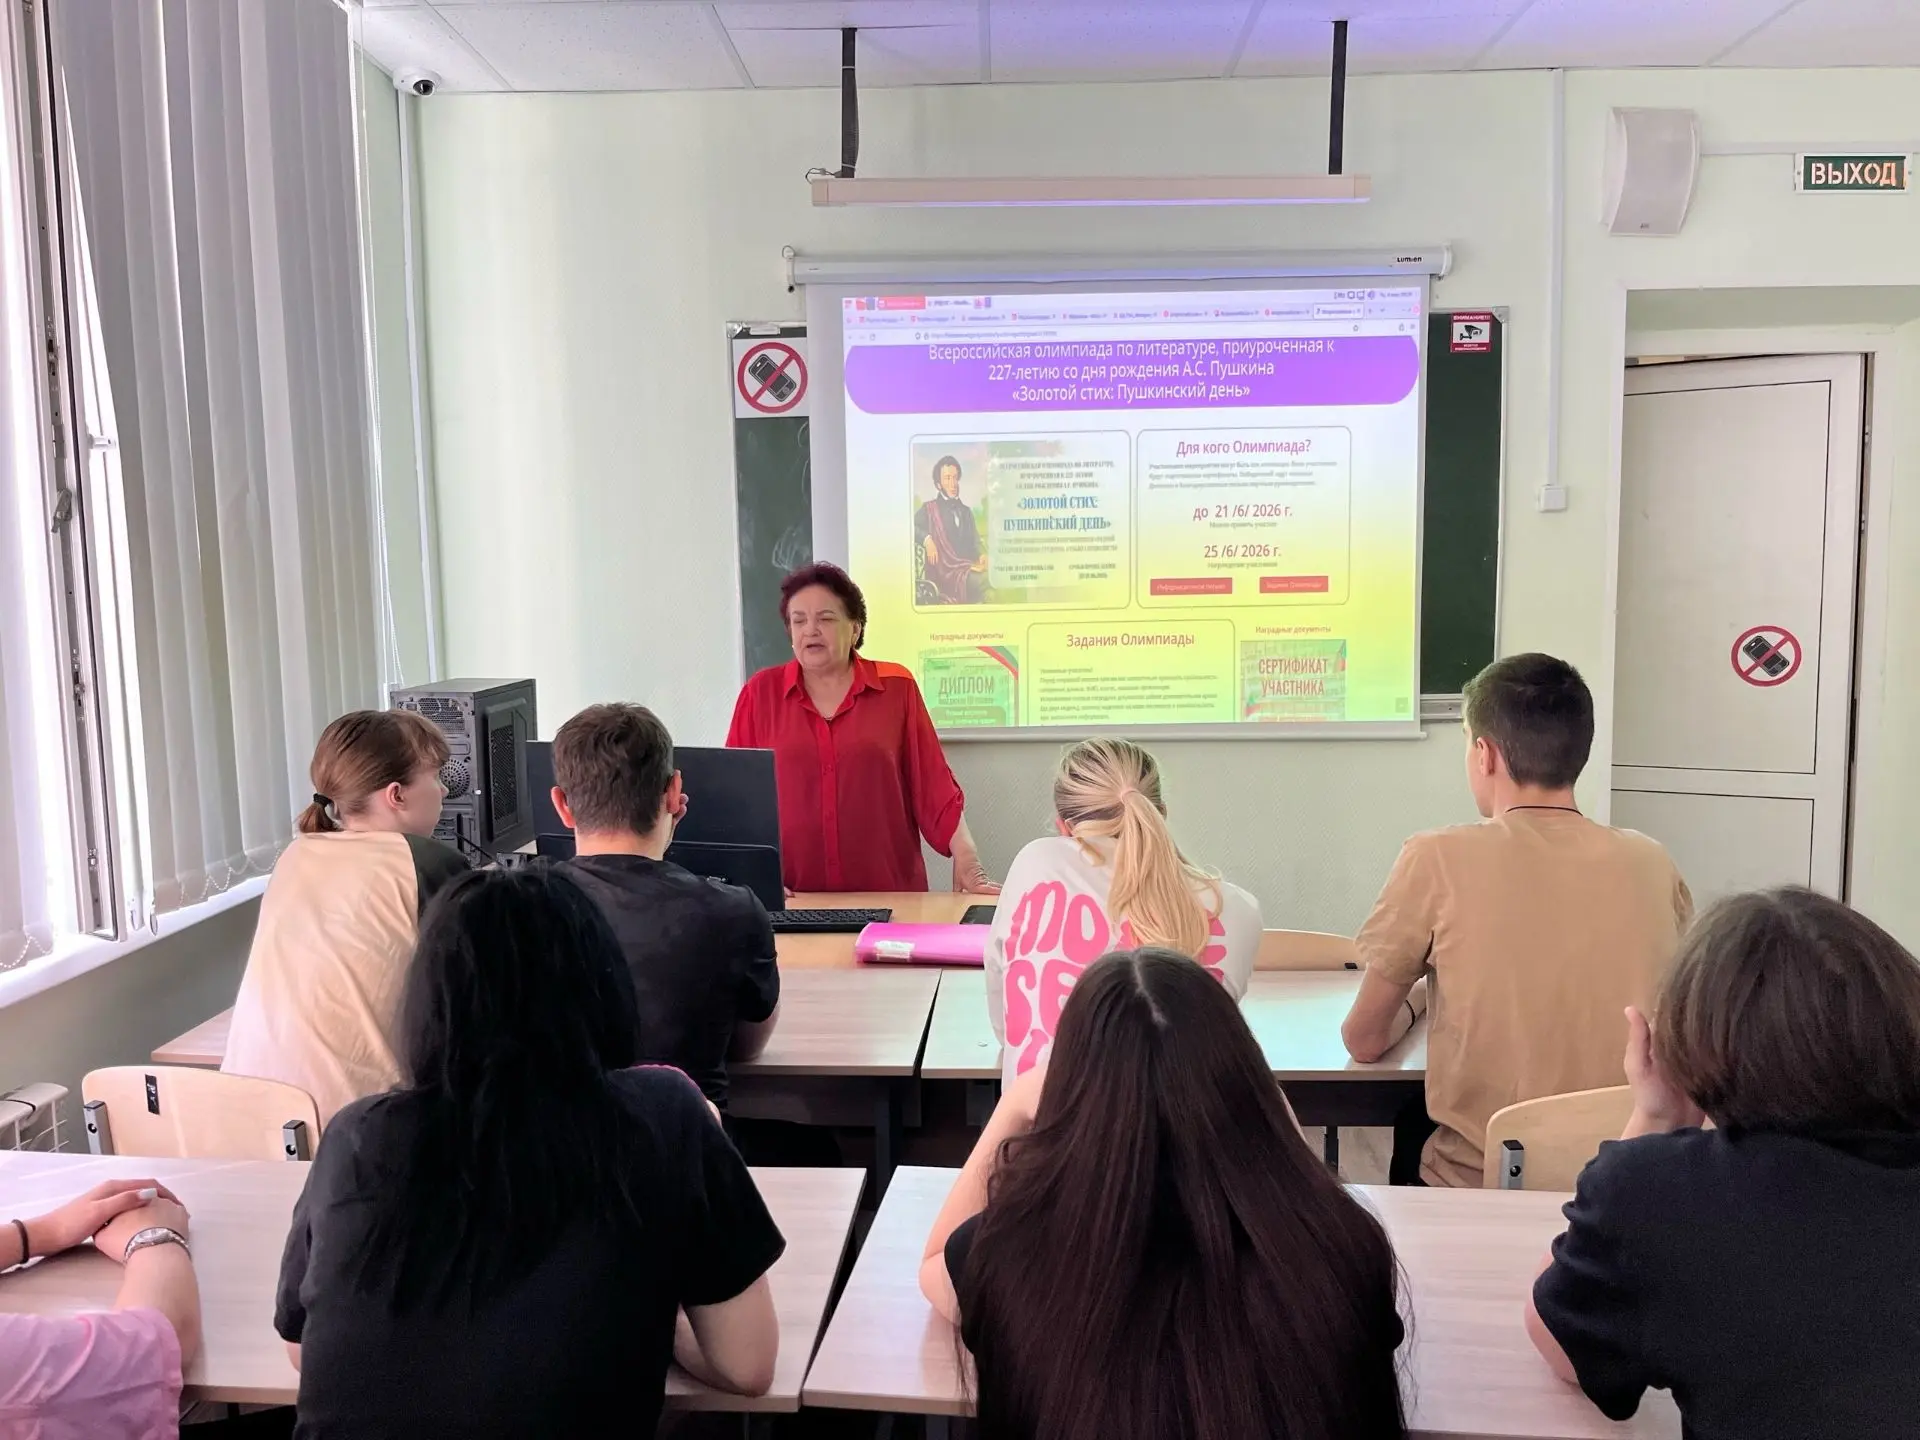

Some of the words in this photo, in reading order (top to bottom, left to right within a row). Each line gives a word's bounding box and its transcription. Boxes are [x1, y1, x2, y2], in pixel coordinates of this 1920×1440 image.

[1811, 162, 1897, 186] ВЫХОД
[929, 341, 1031, 364] Всероссийская
[1034, 342, 1113, 360] олимпиада
[1116, 343, 1133, 356] по
[1136, 341, 1217, 359] литературе,
[1222, 340, 1324, 359] приуроченная
[1327, 340, 1335, 352] к
[988, 364, 1060, 381] 227-летию
[1063, 366, 1078, 380] со
[1081, 364, 1107, 382] дня
[1110, 362, 1179, 381] рождения
[1182, 361, 1207, 377] А.С.
[1210, 360, 1274, 380] Пушкина
[1012, 384, 1076, 402] «Золотой
[1080, 386, 1114, 401] стих:
[1117, 383, 1206, 403] Пушкинский
[1209, 384, 1250, 400] день»
[1176, 441, 1200, 457] Для
[1203, 442, 1230, 455] кого
[1233, 439, 1312, 455] Олимпиада?
[1193, 507, 1209, 521] до
[1215, 505, 1229, 518] 21
[1253, 504, 1282, 517] 2026
[1284, 507, 1293, 517] г.
[1204, 545, 1218, 558] 25
[1241, 544, 1271, 557] 2026
[1273, 546, 1282, 557] г.
[1067, 633, 1118, 650] Задания
[1120, 632, 1195, 648] Олимпиады
[1258, 658, 1328, 675] СЕРТИФИКАТ
[938, 676, 994, 697] ДИПЛОМ
[1261, 680, 1325, 697] УЧАСТНИКА
